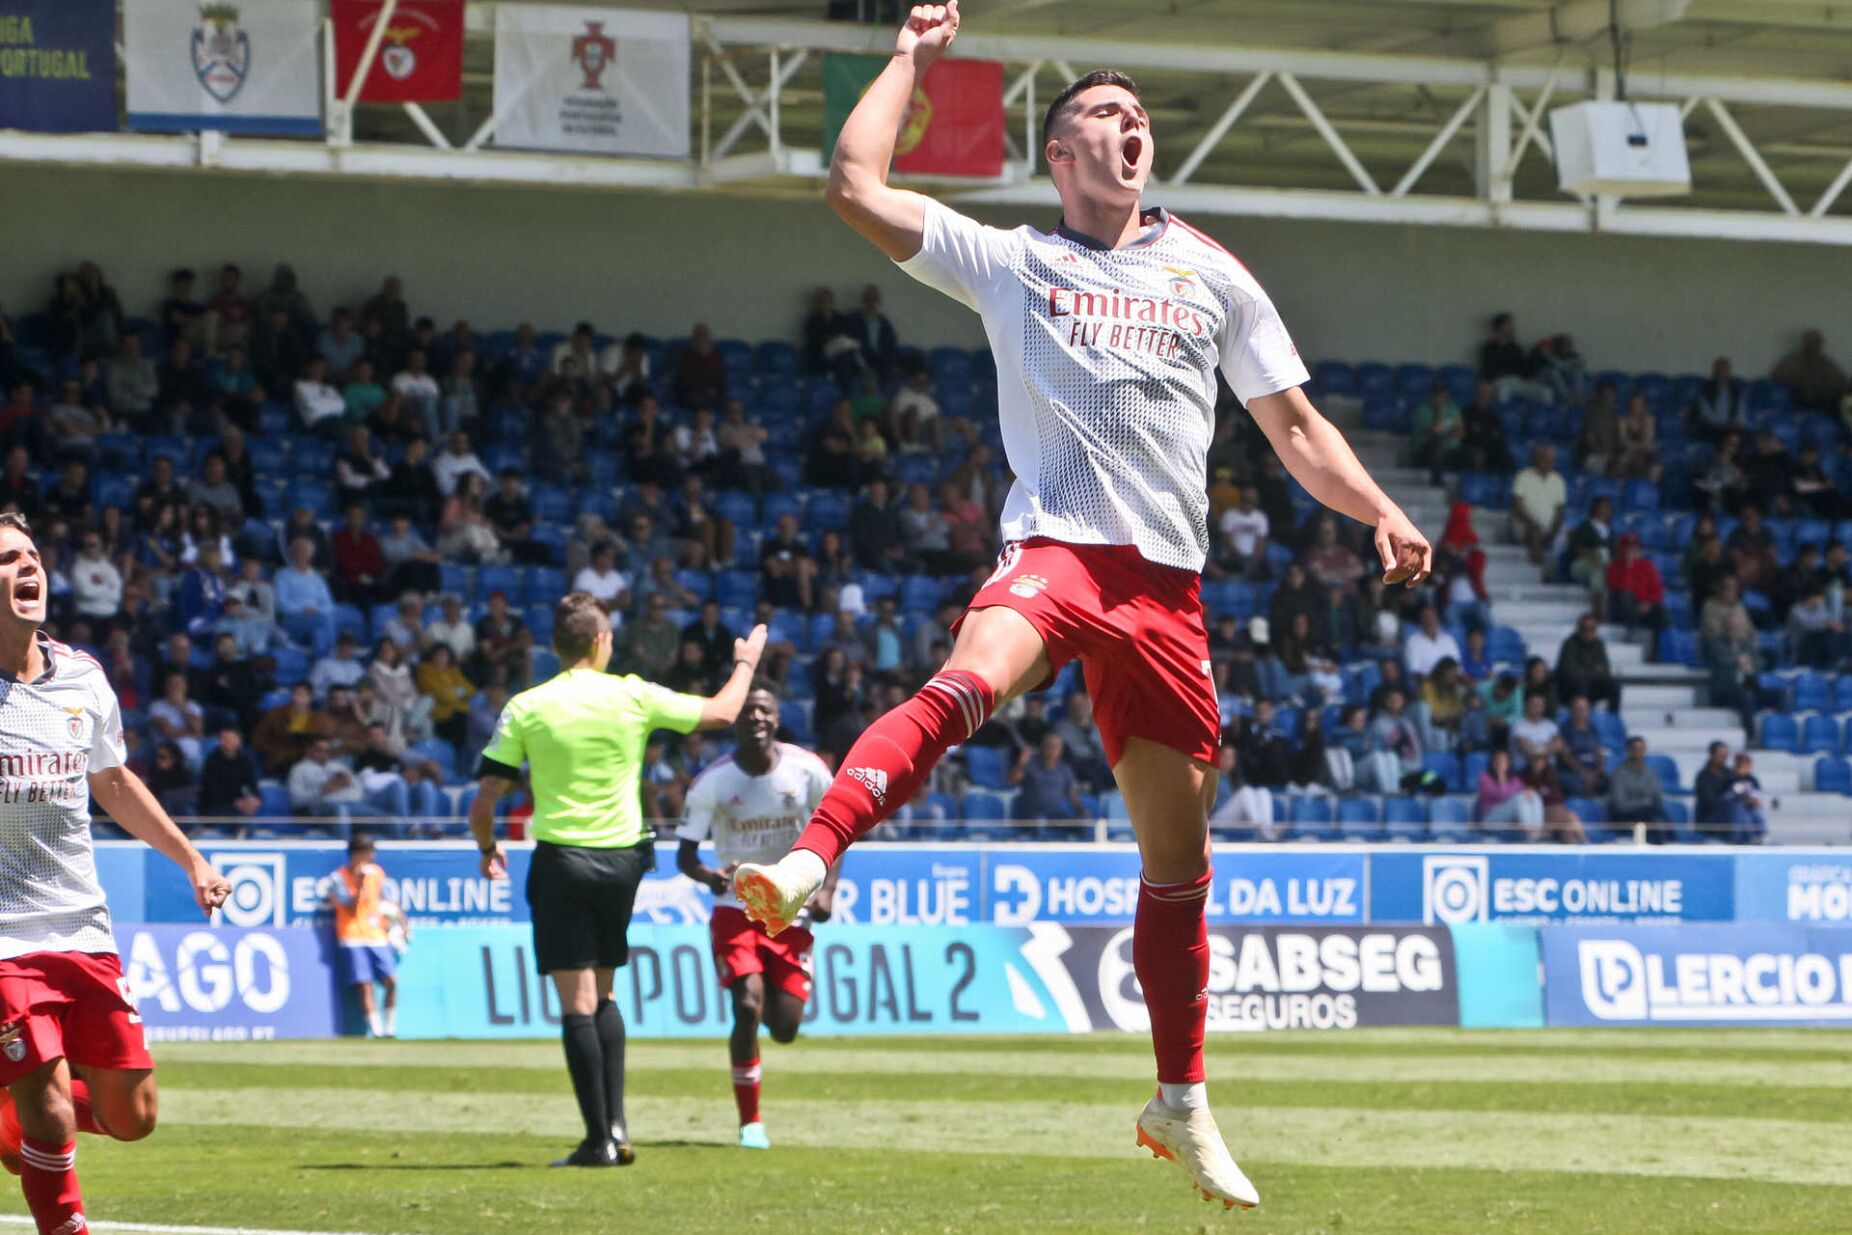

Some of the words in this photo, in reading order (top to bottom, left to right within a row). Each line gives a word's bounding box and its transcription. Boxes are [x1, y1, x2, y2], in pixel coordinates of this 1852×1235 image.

[0, 48, 91, 79] ORTUGAL
[1049, 288, 1203, 336] Emirates
[1070, 321, 1102, 348] FLY
[1109, 323, 1180, 359] BETTER
[0, 748, 86, 776] mirate
[870, 878, 969, 926] BLUE
[1229, 878, 1281, 915] DA
[1287, 878, 1356, 916] LUZ
[1494, 877, 1559, 913] ESC
[1562, 878, 1683, 914] ONLINE
[1787, 884, 1852, 920] MO
[1206, 932, 1443, 993] SABSEG
[1645, 952, 1837, 1006] LERCIO
[946, 942, 980, 1022] 2
[1206, 993, 1358, 1031] SEGUROS
